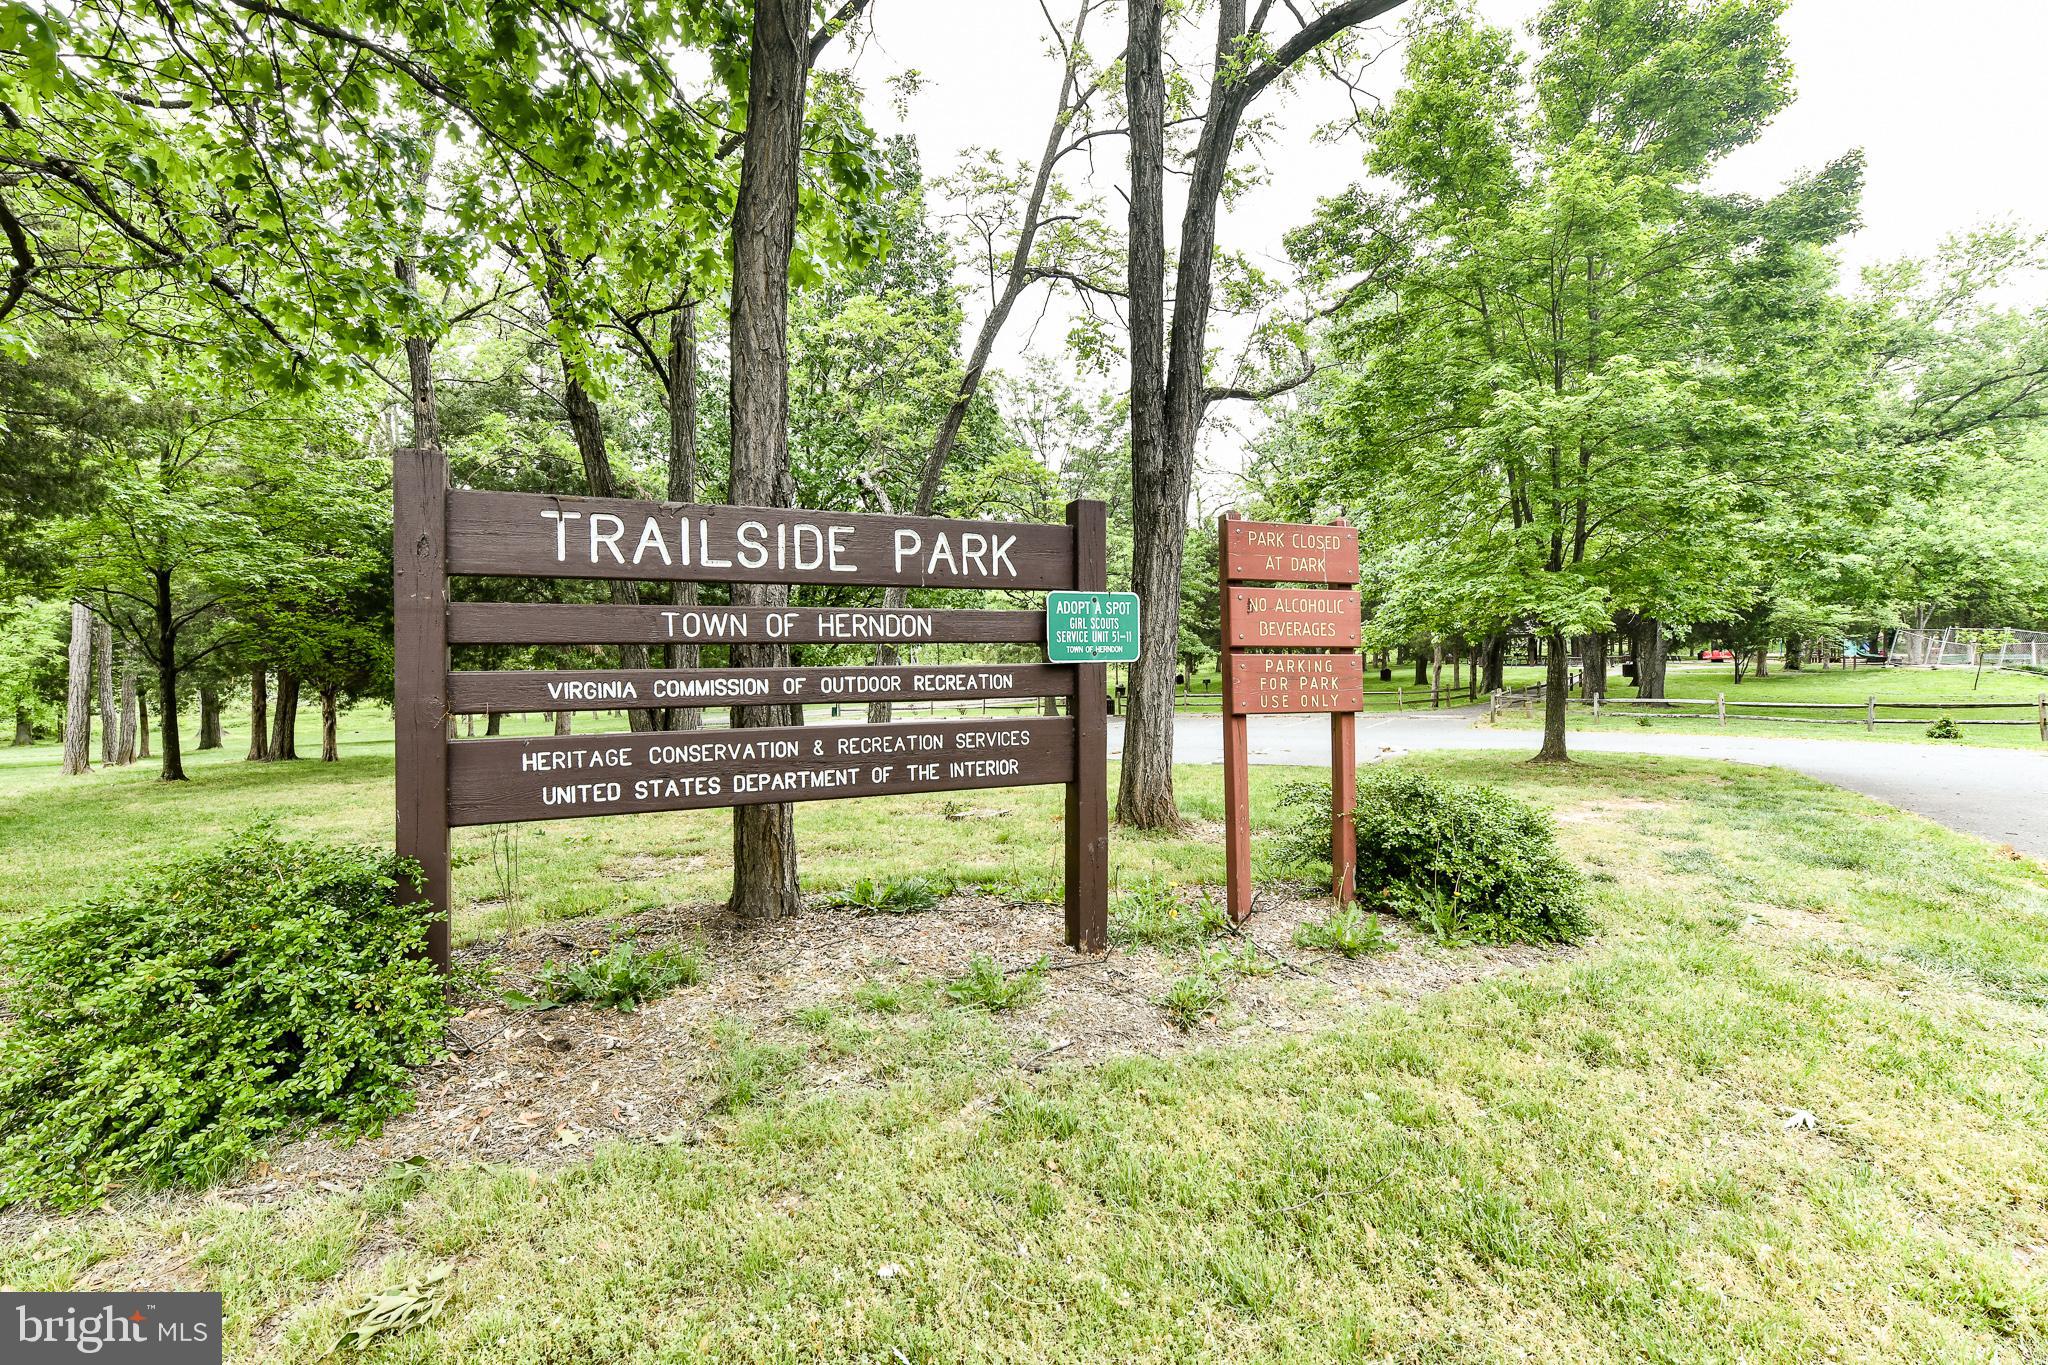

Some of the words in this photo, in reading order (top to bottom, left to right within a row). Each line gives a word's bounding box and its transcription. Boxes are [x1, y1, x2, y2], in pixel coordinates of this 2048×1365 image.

[540, 510, 858, 572] TRAILSIDE
[894, 528, 1018, 577] PARK
[1248, 530, 1285, 548] PARK
[1292, 533, 1341, 550] CLOSED
[1265, 556, 1282, 571] AT
[1291, 556, 1326, 572] DARK
[1055, 600, 1090, 615] ADOPT
[1094, 601, 1102, 615] A
[1105, 601, 1131, 615] SPOT
[1249, 597, 1267, 612] NO
[1276, 597, 1344, 614] ALCOHOLIC
[661, 611, 748, 637] TOWN
[766, 612, 799, 637] OF
[818, 613, 932, 638] HERNDON
[1069, 617, 1088, 630] GIRL
[1090, 617, 1119, 630] SCOUTS
[1259, 621, 1336, 637] BEVERAGES
[1056, 630, 1089, 643] SERVICE
[1091, 630, 1109, 643] UNIT
[1112, 630, 1132, 643] 51-11
[1066, 645, 1084, 653] TOWN
[1085, 645, 1094, 653] OF
[1095, 645, 1123, 653] HERNDON
[1265, 659, 1332, 673] PARKING
[547, 681, 638, 700] VIRGINIA
[653, 677, 770, 698] COMMISSION
[783, 677, 806, 695] OF
[820, 675, 902, 694] OUTDOOR
[915, 673, 1013, 691] RECREATION
[1260, 677, 1288, 691] FOR
[1300, 677, 1339, 690] PARK
[1260, 694, 1289, 708] USE
[1300, 693, 1339, 708] ONLY
[522, 747, 632, 772] HERITAGE
[648, 740, 799, 763] CONSERVATION
[813, 739, 824, 756] &
[837, 734, 944, 755] RECREATION
[955, 730, 1030, 748] SERVICES
[542, 782, 621, 806] UNITED
[634, 776, 721, 799] STATES
[733, 767, 860, 793] DEPARTMENT
[871, 766, 894, 784] OF
[906, 763, 940, 782] THE
[949, 758, 1019, 778] INTERIOR
